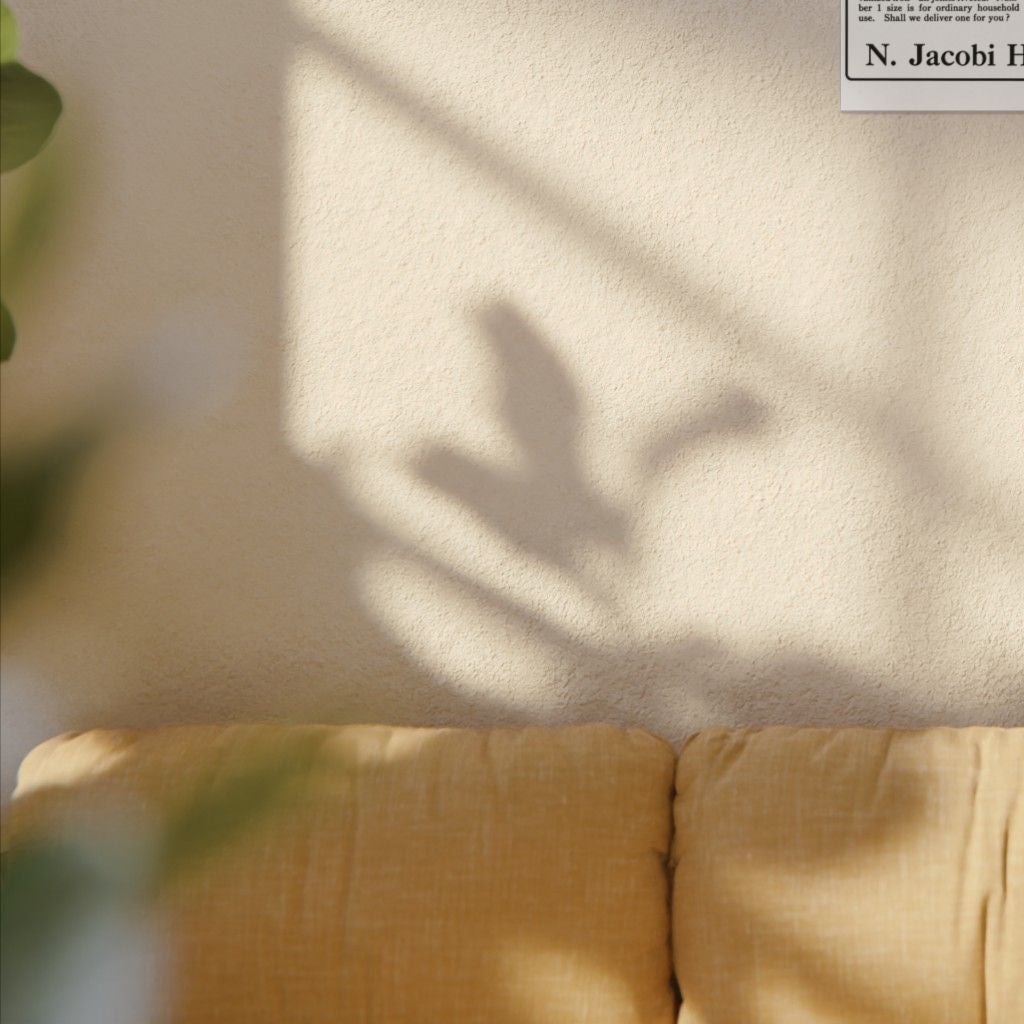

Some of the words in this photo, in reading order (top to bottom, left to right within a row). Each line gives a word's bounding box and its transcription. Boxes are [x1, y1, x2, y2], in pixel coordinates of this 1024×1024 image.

[936, 4, 972, 13] ordinary
[866, 44, 896, 66] N.
[909, 44, 995, 66] Jacobi
